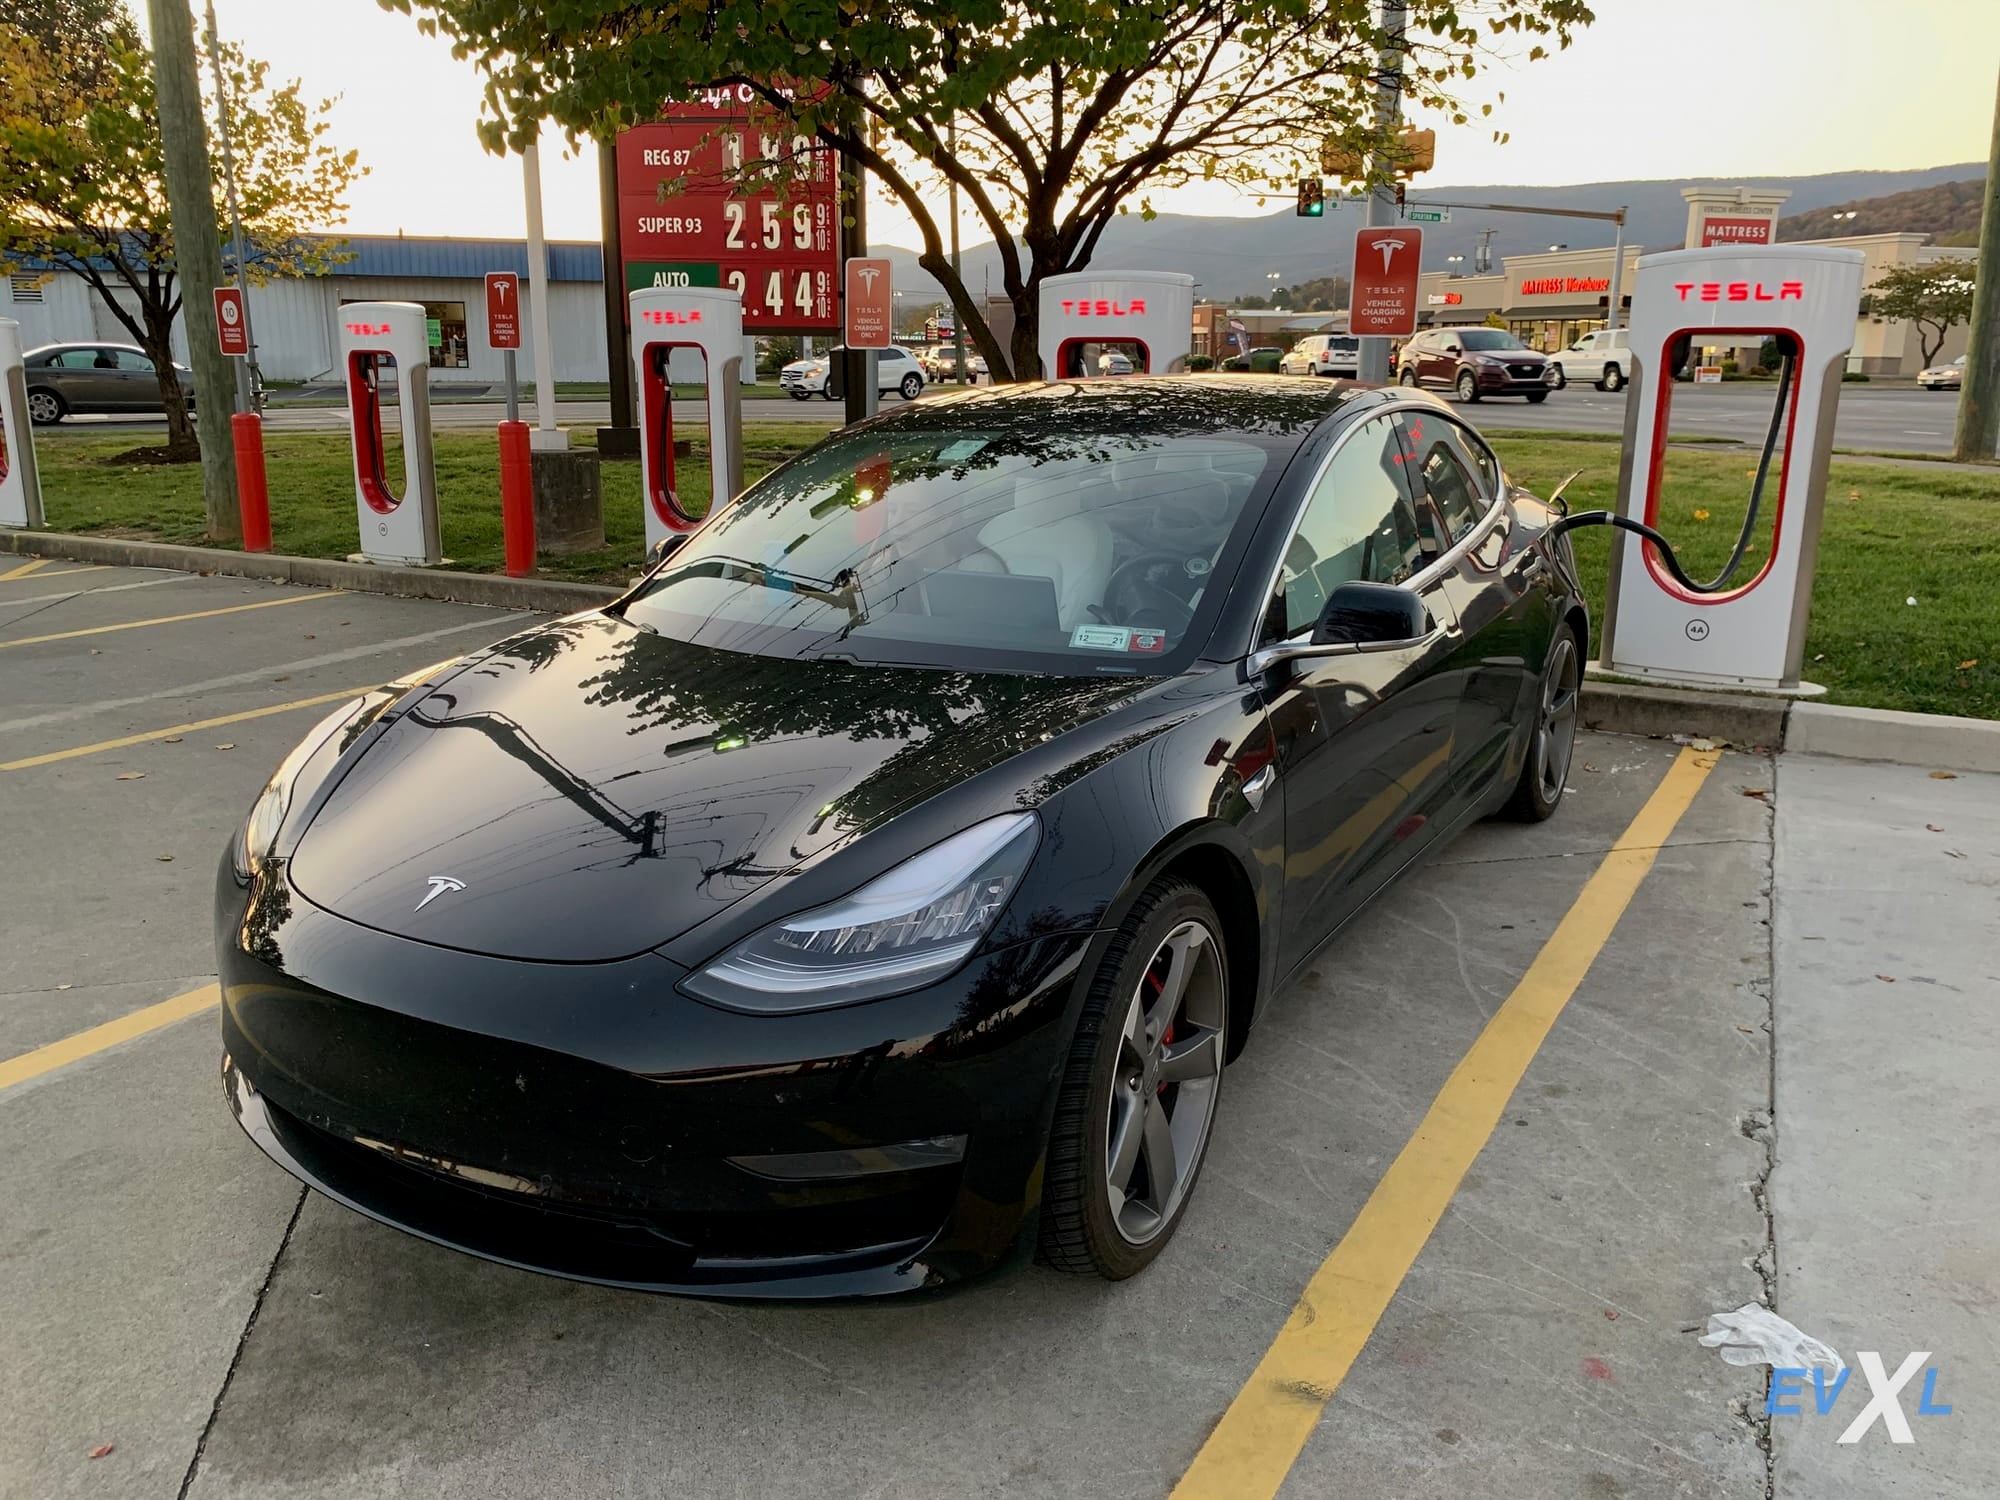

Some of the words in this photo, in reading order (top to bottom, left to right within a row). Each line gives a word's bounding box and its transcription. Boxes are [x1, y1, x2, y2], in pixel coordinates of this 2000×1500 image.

[644, 149, 670, 166] REG
[673, 150, 690, 166] 87
[638, 217, 682, 233] SUPER
[685, 218, 702, 233] 93
[1705, 225, 1767, 238] MATTRESS
[653, 271, 690, 287] AUTO
[1365, 286, 1405, 294] TESLA
[1522, 277, 1562, 295] MATTRESS
[1672, 282, 1804, 302] TESLA
[1060, 299, 1147, 317] TESLA
[1366, 299, 1402, 307] VEHICLE
[225, 307, 235, 318] 10
[643, 311, 702, 325] TESLA
[1361, 308, 1406, 316] CHARGING
[1370, 316, 1395, 324] ONLY
[345, 322, 391, 336] TESLA
[854, 324, 884, 332] CHARGING
[1690, 626, 1704, 634] 4A
[1079, 634, 1089, 642] 12
[1112, 637, 1124, 645] 21
